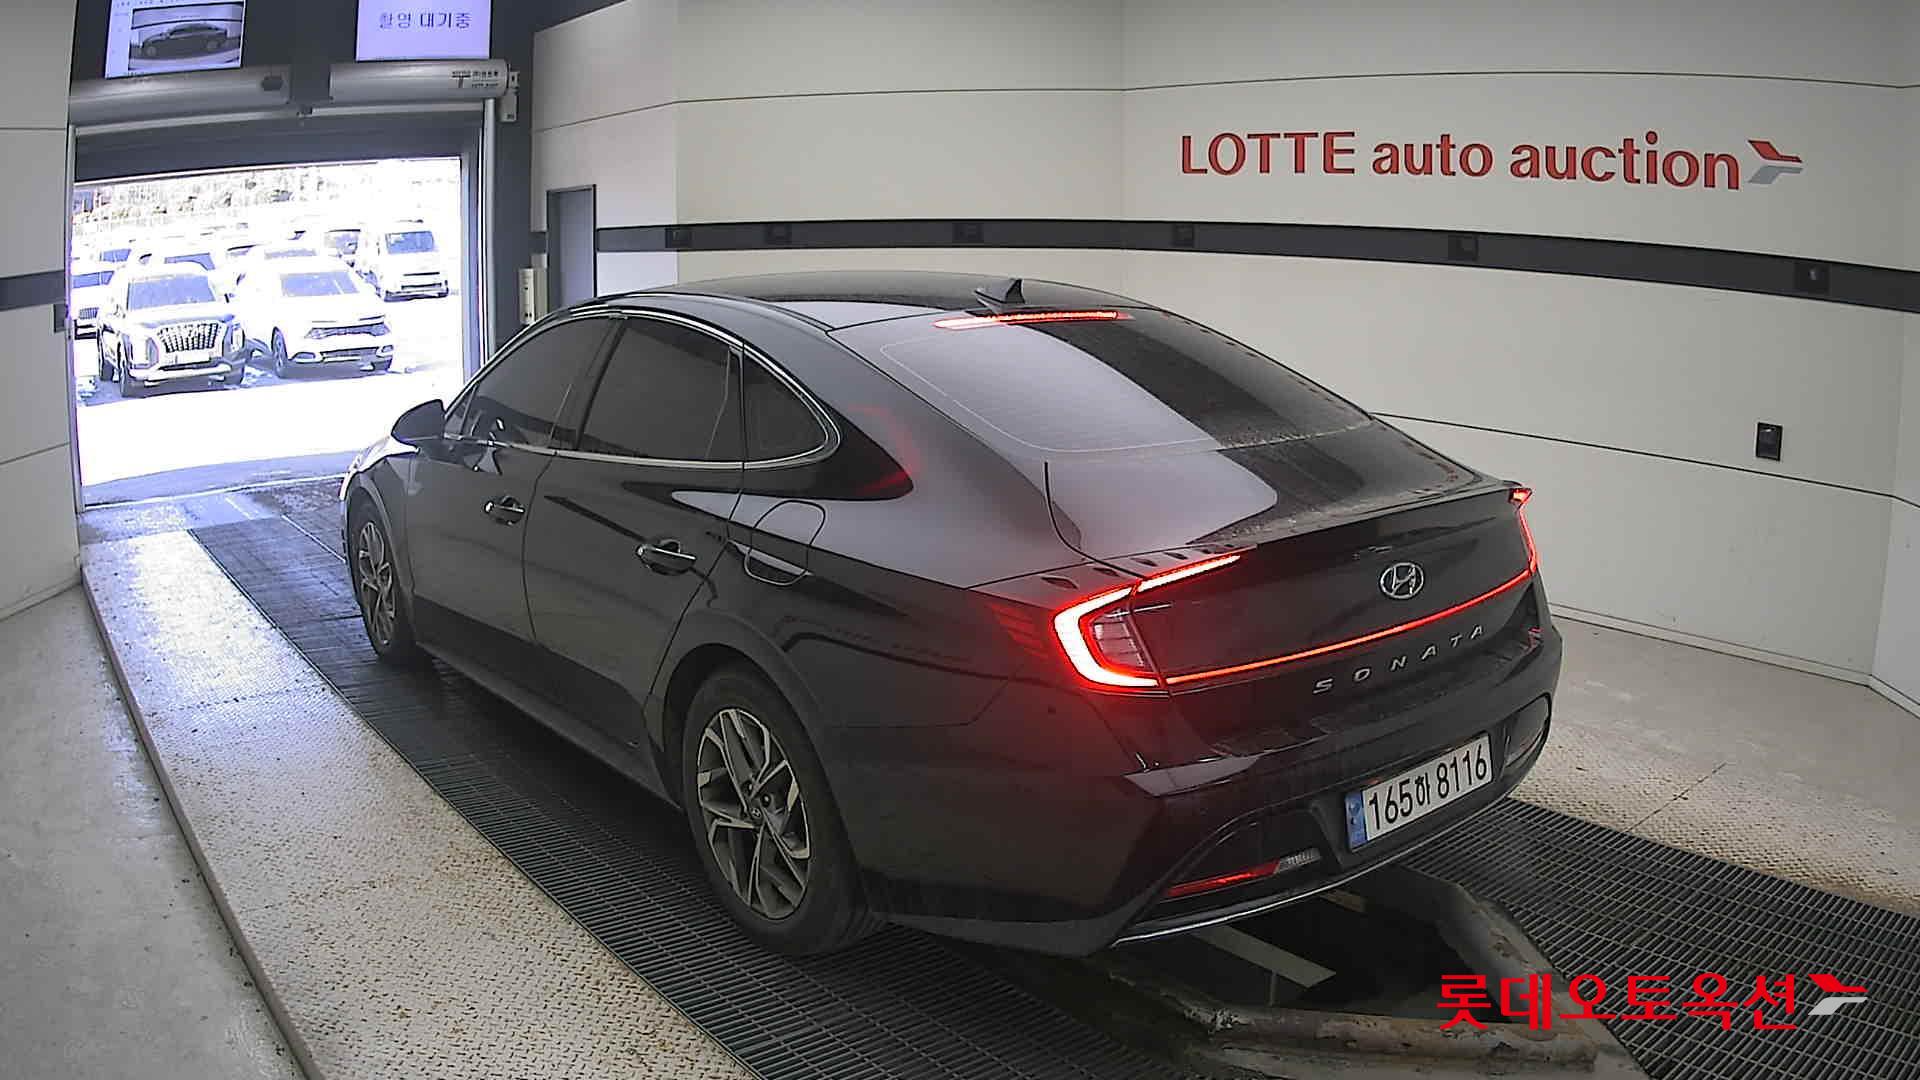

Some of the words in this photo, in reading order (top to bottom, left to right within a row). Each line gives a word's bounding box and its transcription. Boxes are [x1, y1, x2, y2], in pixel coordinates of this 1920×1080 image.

[419, 12, 472, 30] 대기중
[1181, 131, 1356, 176] LOTTE
[1372, 133, 1494, 178] auto
[1509, 130, 1741, 190] auction
[1312, 625, 1485, 694] SONATA
[1368, 772, 1431, 831] 165하
[1436, 743, 1488, 799] 8116
